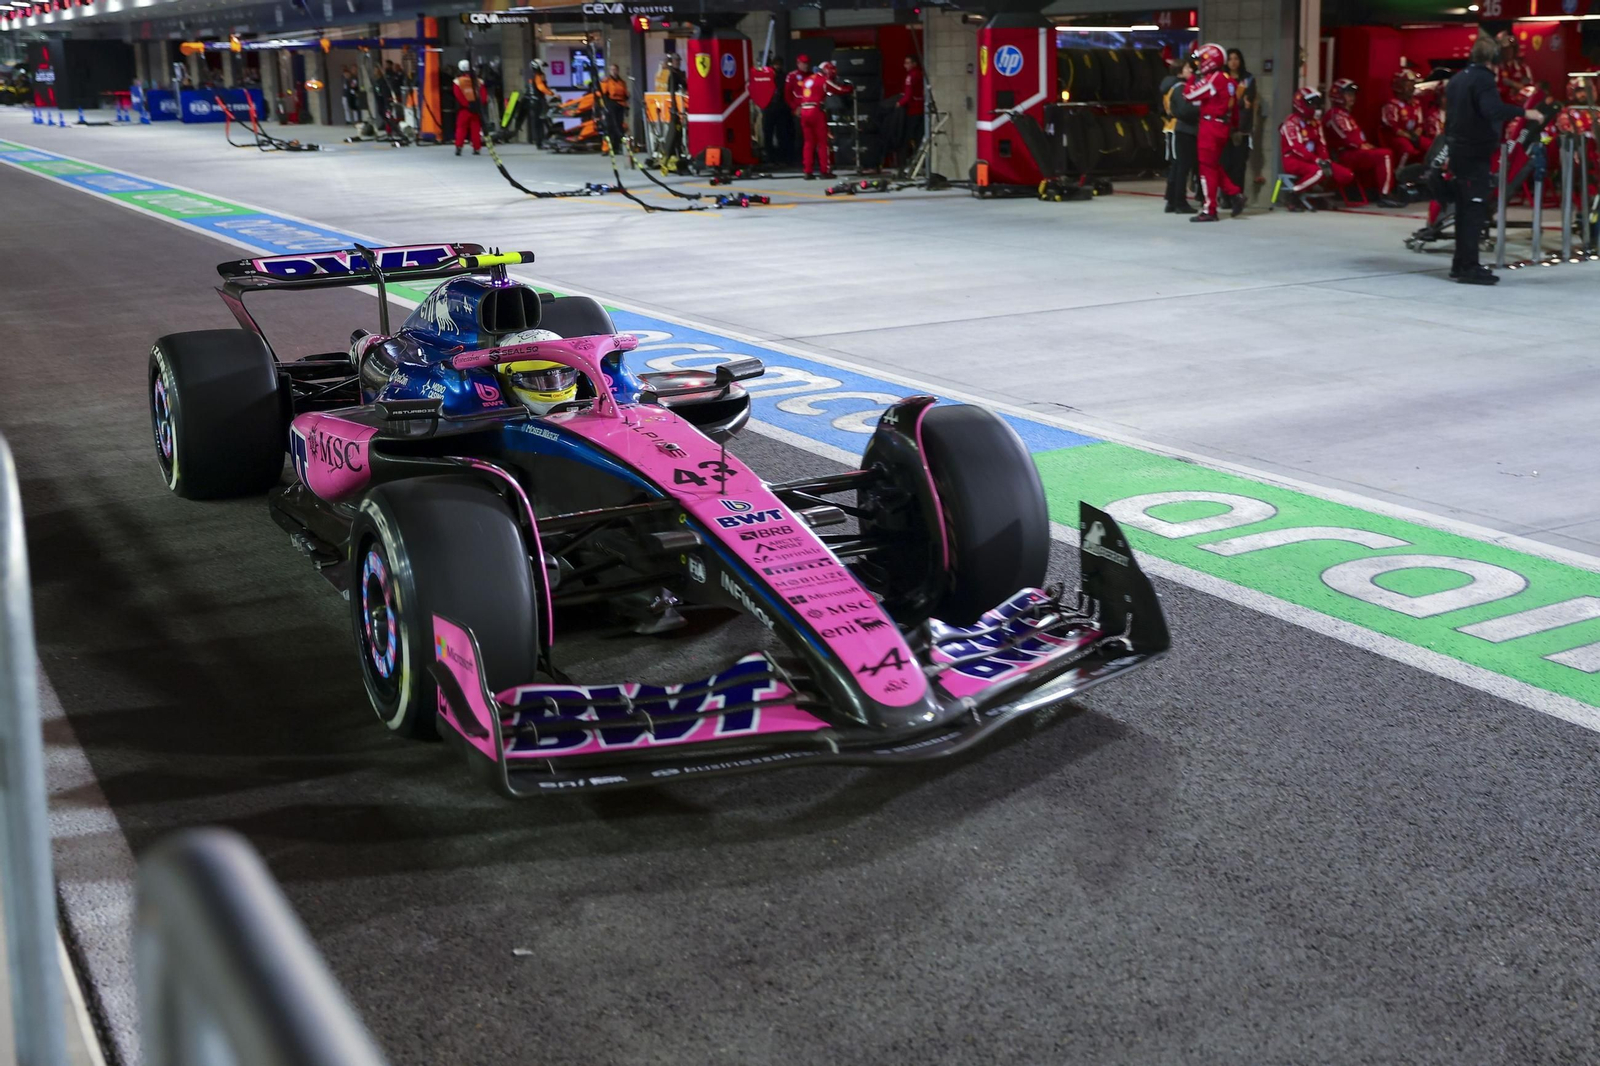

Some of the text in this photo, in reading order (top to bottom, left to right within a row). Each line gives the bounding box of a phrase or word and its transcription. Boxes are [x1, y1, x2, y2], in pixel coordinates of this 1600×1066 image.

[582, 3, 674, 15] CEVA LOGISTICS
[470, 13, 498, 24] CEVA
[1000, 46, 1020, 76] hp
[319, 431, 363, 473] MSC
[673, 460, 738, 487] 43
[715, 509, 784, 529] BWT
[757, 525, 794, 539] BRB
[774, 571, 848, 588] MOBILIZE
[807, 586, 861, 602] Microsoft
[825, 599, 873, 616] MSC
[820, 620, 859, 639] eni
[506, 654, 778, 753] BWT
